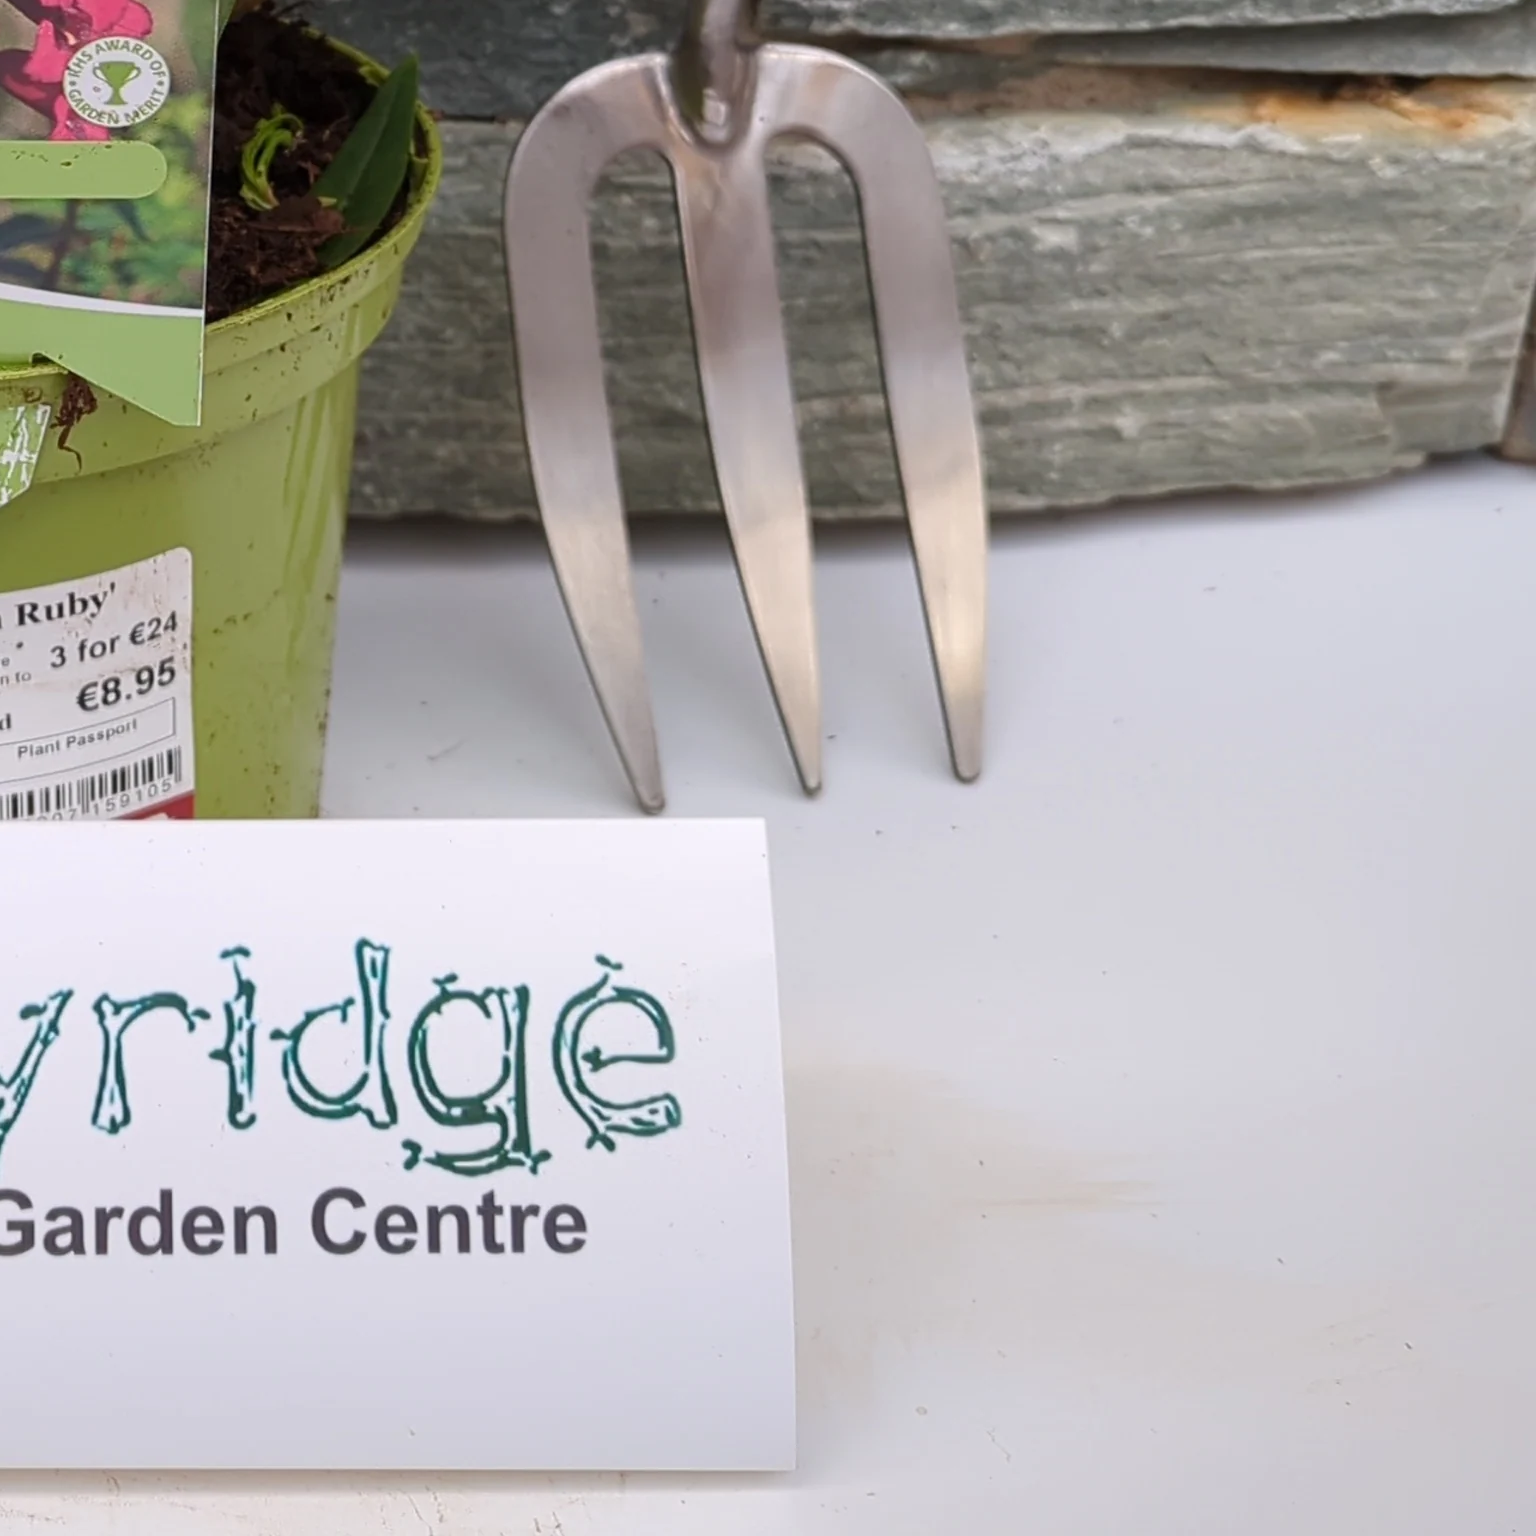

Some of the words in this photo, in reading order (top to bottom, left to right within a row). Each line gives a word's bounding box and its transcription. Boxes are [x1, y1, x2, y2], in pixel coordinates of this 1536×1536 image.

[67, 50, 94, 79] RHS
[95, 39, 154, 65] AWARD
[149, 60, 167, 78] OF
[68, 89, 120, 125] GARDEN
[124, 88, 165, 124] MERIT
[14, 581, 117, 627] Ruby'
[49, 645, 66, 669] 3
[78, 634, 121, 663] for
[129, 610, 179, 646] €24
[15, 670, 33, 683] to
[76, 655, 176, 712] €8.95
[17, 737, 61, 759] Plant
[66, 718, 137, 748] Passport
[92, 779, 173, 816] 159105
[309, 1187, 589, 1256] Centre
